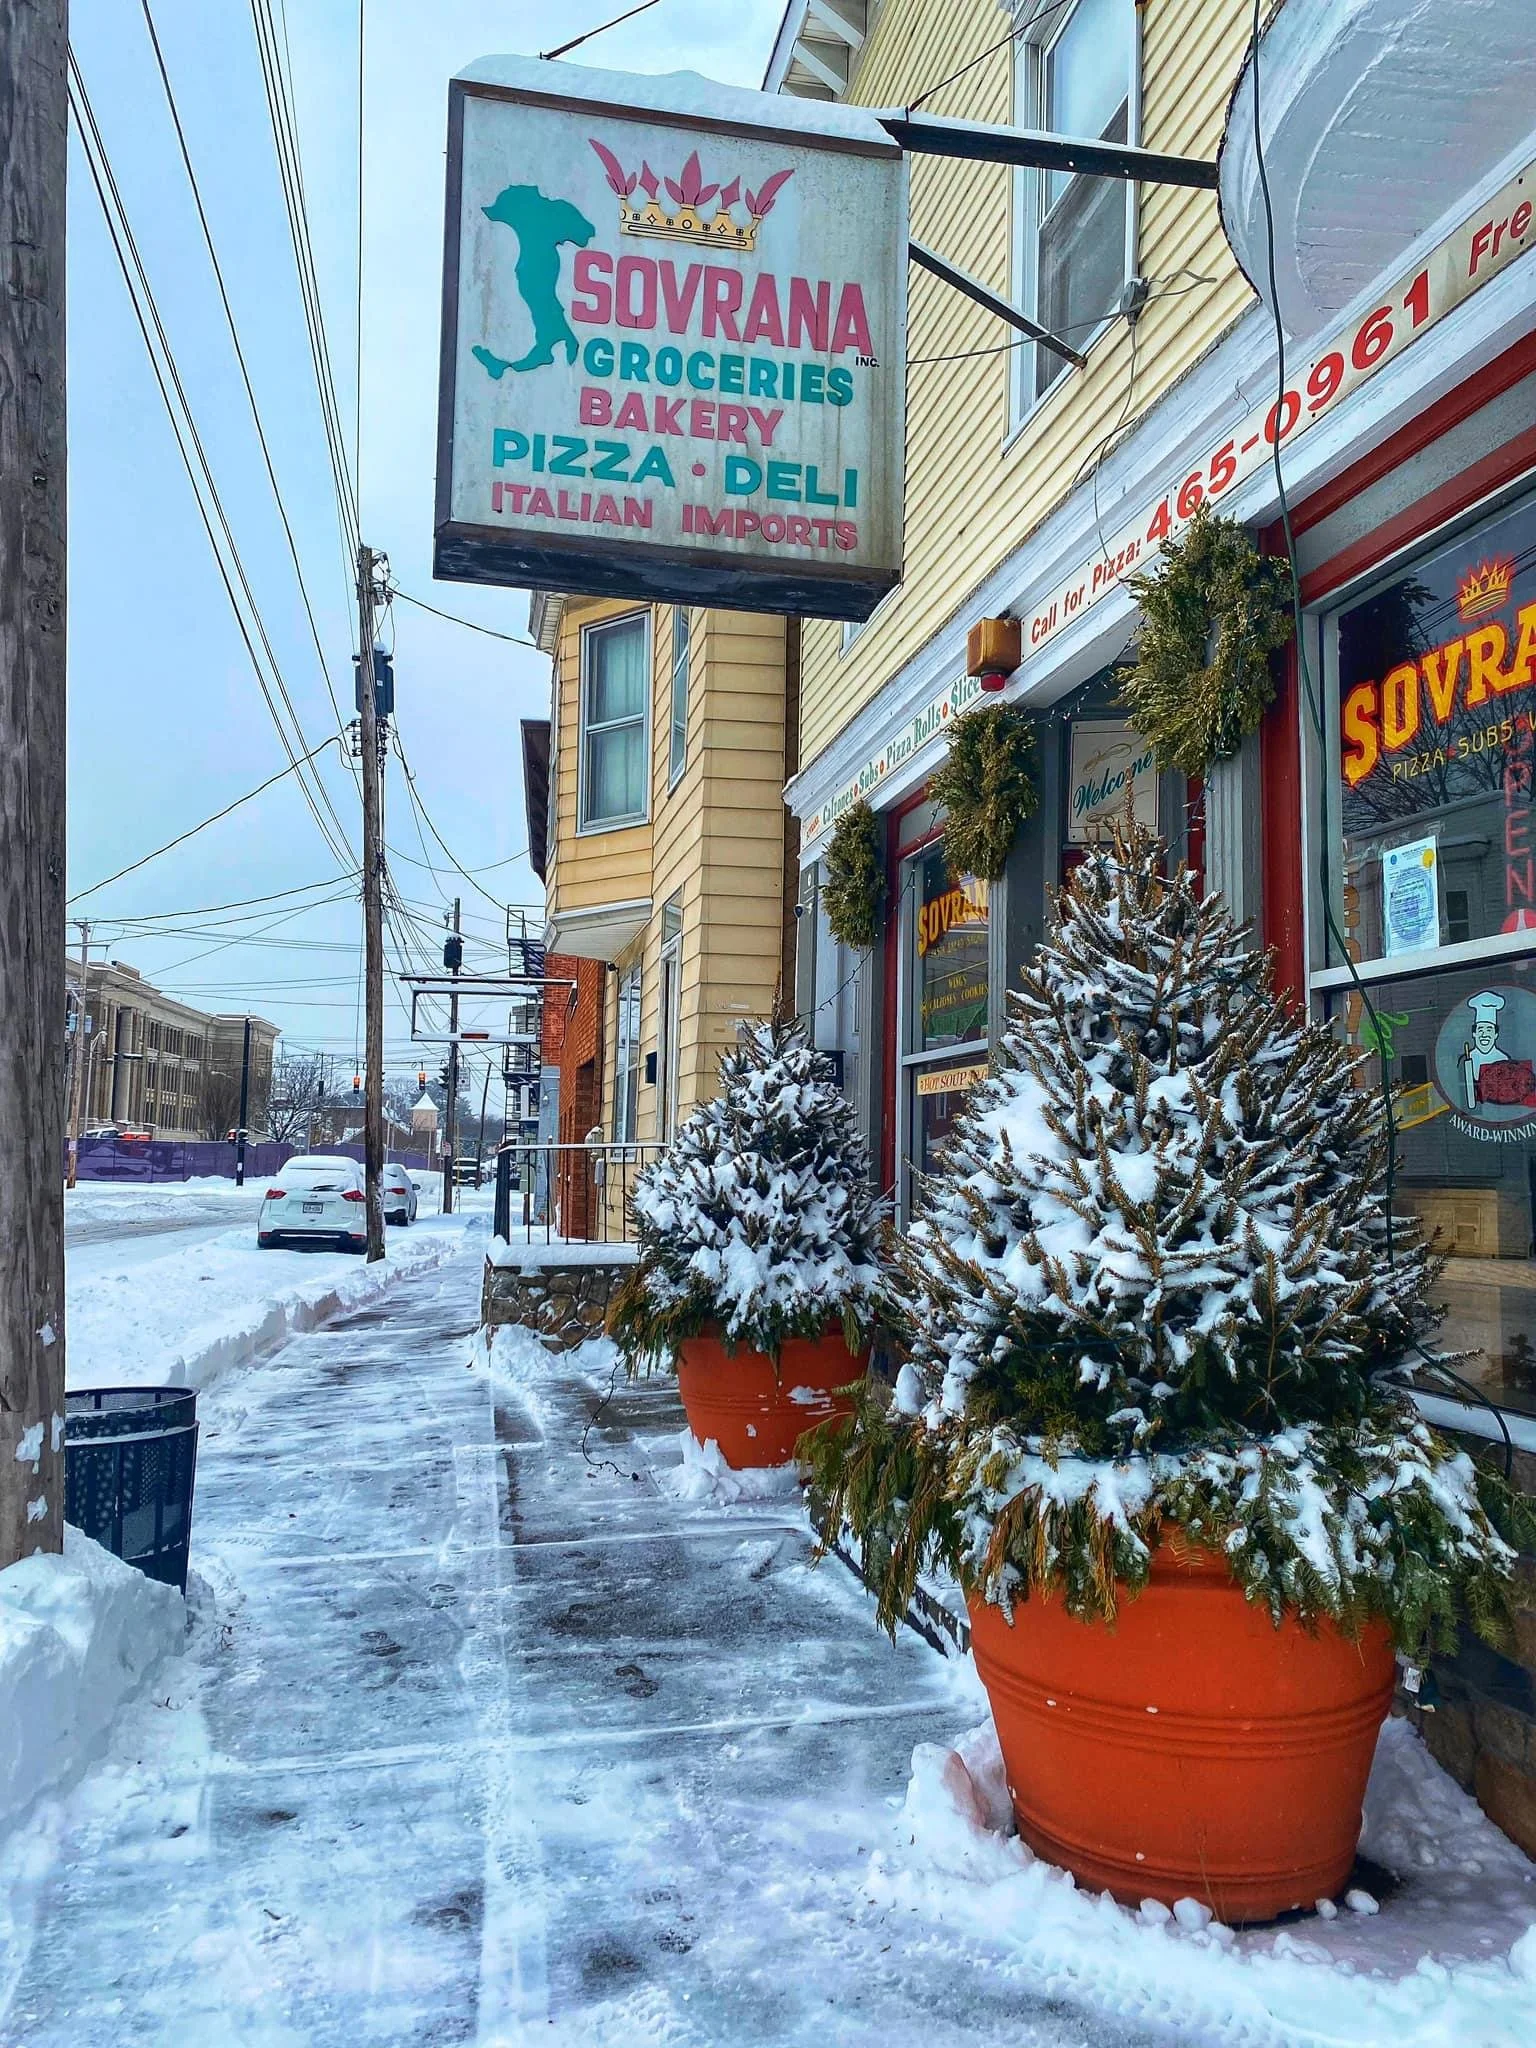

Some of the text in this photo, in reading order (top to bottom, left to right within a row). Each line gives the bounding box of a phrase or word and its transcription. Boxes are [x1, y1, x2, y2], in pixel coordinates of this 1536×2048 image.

[571, 249, 875, 357] SOVRANA
[583, 336, 854, 407] GROCERIES
[855, 355, 881, 368] INC.
[579, 386, 785, 447] BAKERY
[491, 427, 859, 508] PIZZA DELI
[1031, 599, 1057, 646] Call
[1063, 583, 1087, 616] for
[1091, 539, 1141, 592] Pizza:
[1145, 269, 1432, 544] 465-0961
[491, 481, 859, 551] ITALIAN IMPORTS
[858, 761, 880, 794] Subs
[886, 734, 912, 770] Pizza
[914, 703, 942, 746] Rolls
[1392, 747, 1445, 785] PIZZA
[1457, 719, 1513, 760] SUBS
[940, 1072, 967, 1090] SOUP
